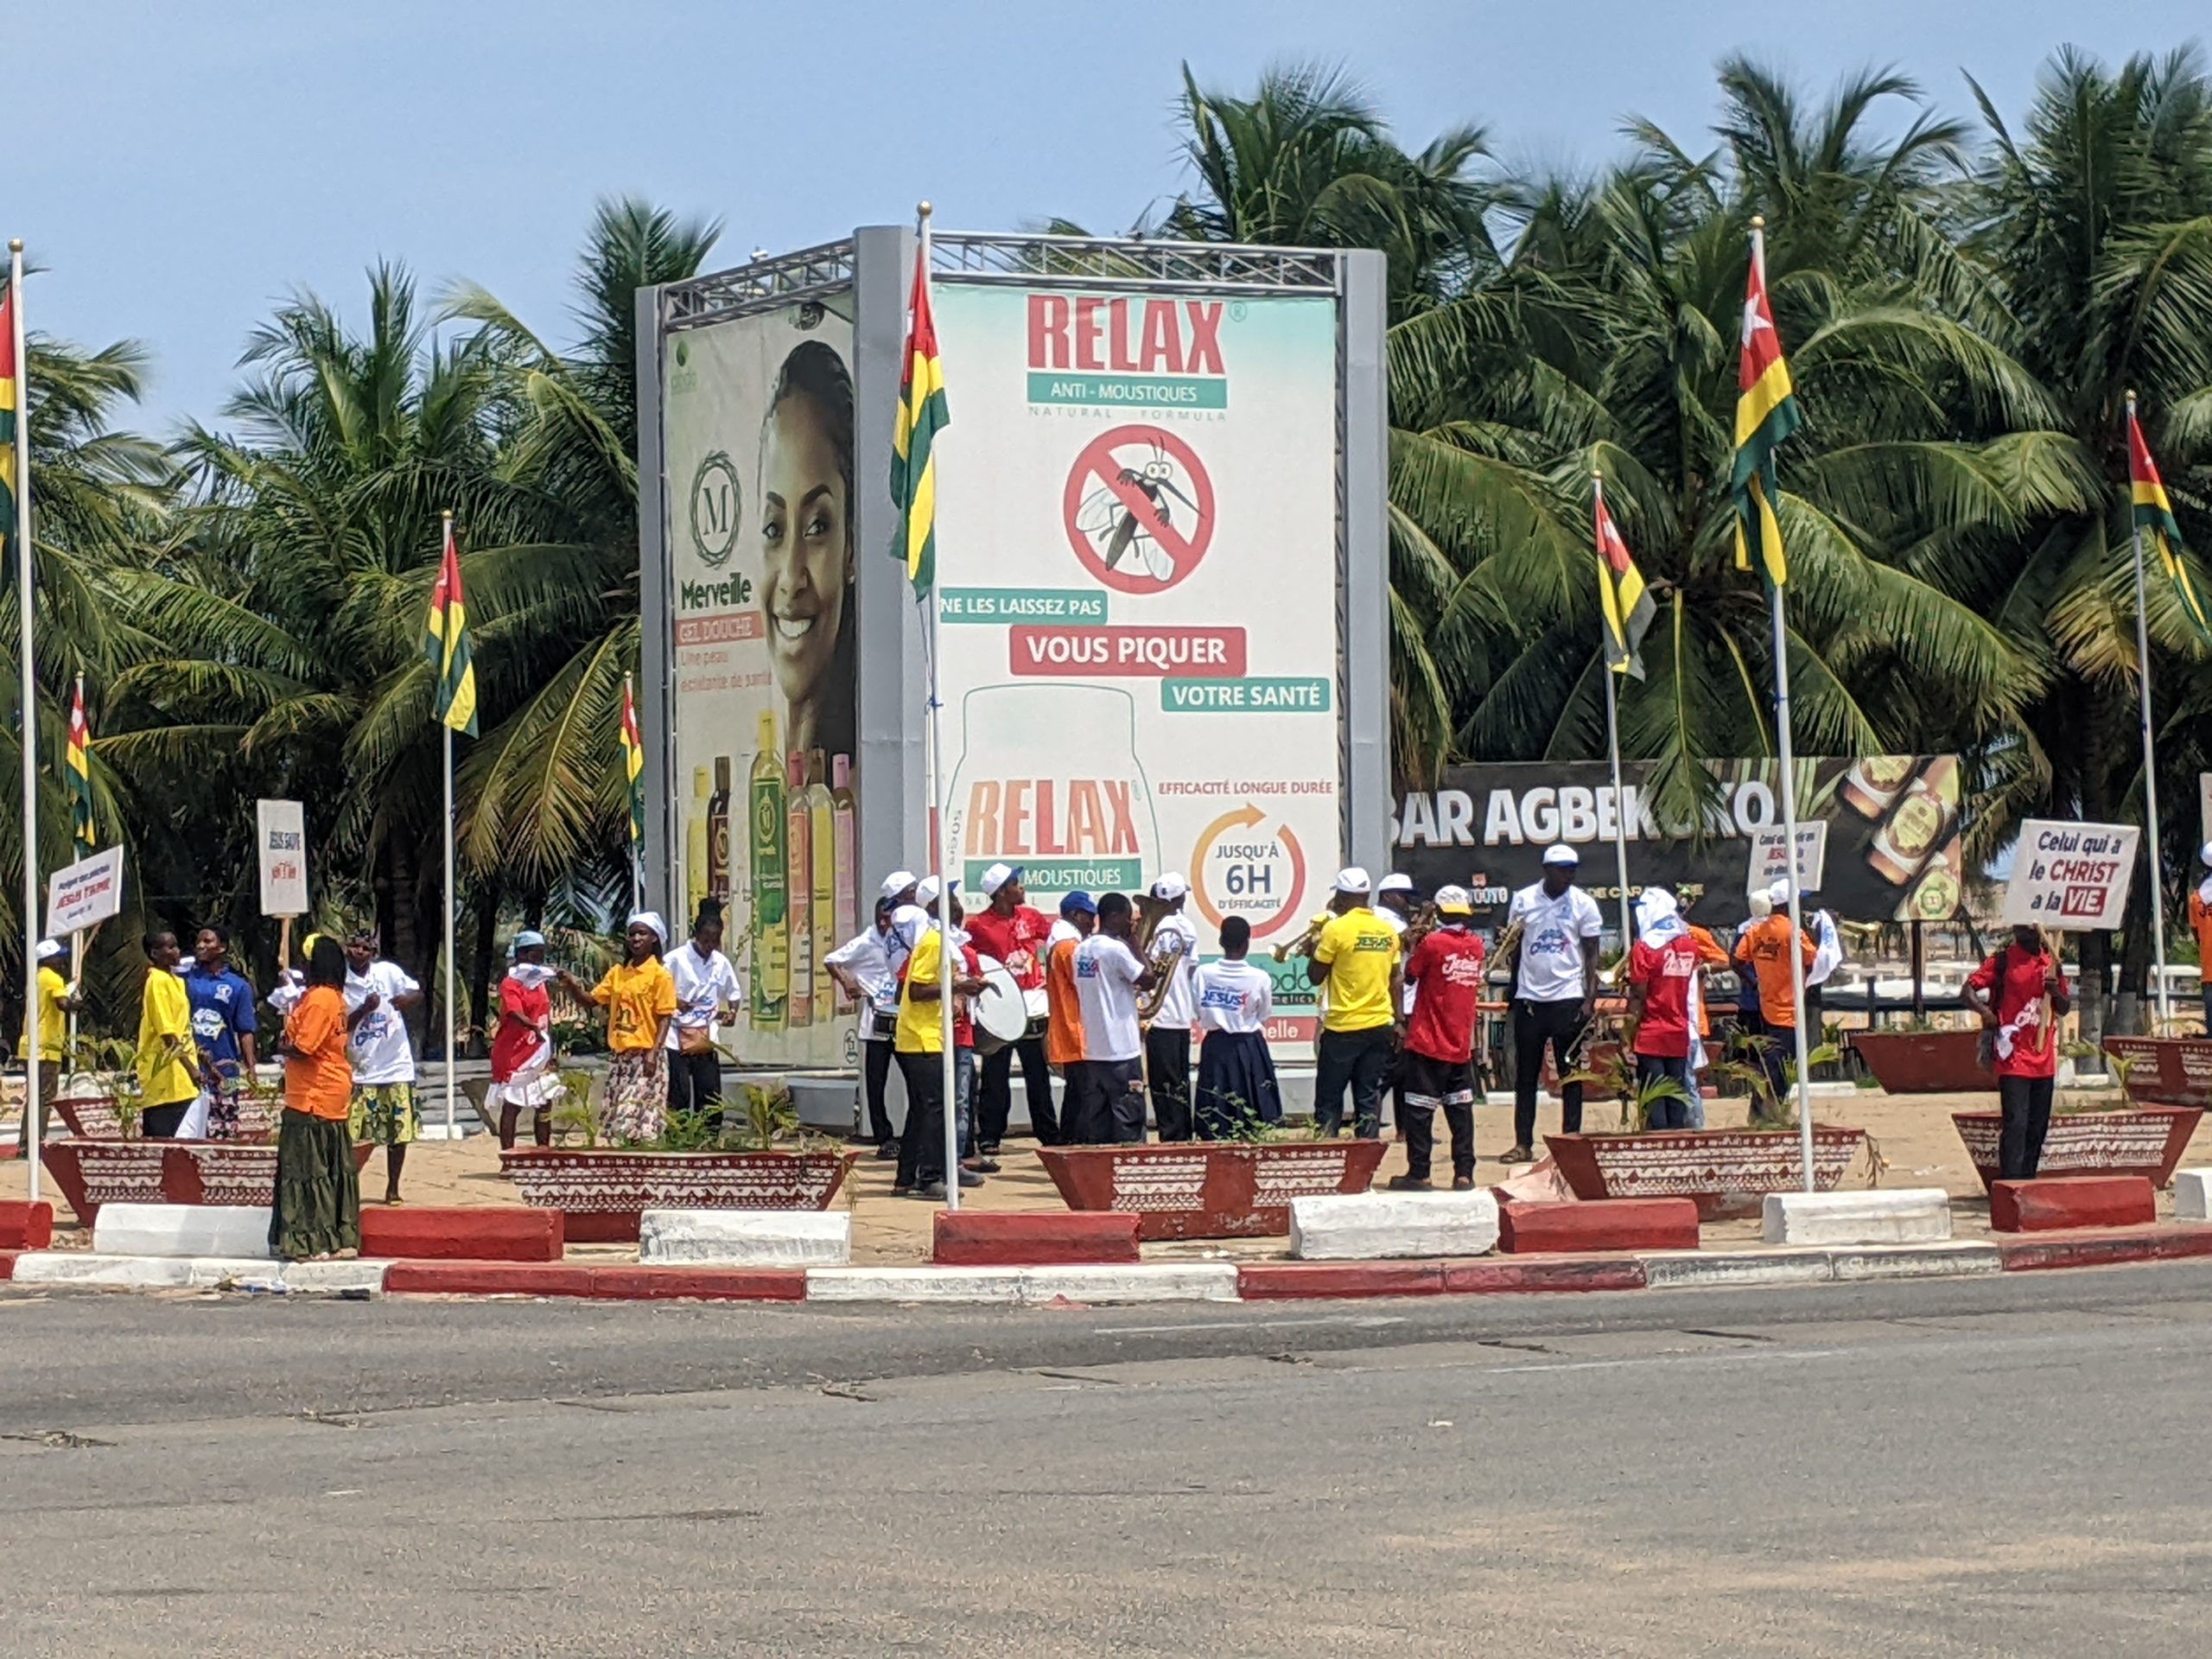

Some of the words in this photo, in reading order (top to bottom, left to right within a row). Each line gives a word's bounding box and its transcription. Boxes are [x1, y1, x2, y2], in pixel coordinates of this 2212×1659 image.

[1027, 294, 1225, 374] RELAX
[1051, 382, 1085, 398] ANTI
[1098, 383, 1198, 403] MOUSTIQUES
[1028, 407, 1112, 419] NATURAL
[1141, 410, 1227, 422] FORMULA
[681, 572, 753, 610] Merveille
[940, 598, 963, 614] NE
[966, 598, 995, 614] LES
[1000, 599, 1065, 615] LAISSEZ
[1069, 600, 1102, 615] PAS
[702, 616, 753, 640] DOUCHE
[1026, 635, 1109, 664] VOUS
[1118, 637, 1228, 671] PIQUER
[1172, 685, 1245, 706] VOTRE
[1249, 683, 1321, 706] SANTÉ
[1159, 779, 1230, 795] EFFICACITÉ
[1234, 782, 1287, 794] LONGUE
[1291, 779, 1332, 794] DURÉE
[965, 779, 1140, 855] RELAX
[1392, 790, 1475, 848] AR
[1216, 841, 1280, 861] JUSQU'À
[2037, 831, 2081, 853] Celui
[2082, 835, 2111, 856] qui
[2111, 837, 2122, 855] a
[1023, 868, 1122, 887] MOUSTIQUES
[1225, 864, 1271, 894] 6H
[2029, 859, 2045, 880] le
[2031, 893, 2043, 910] a
[2045, 890, 2062, 910] la
[2067, 888, 2102, 912] VIE
[1201, 990, 1243, 1006] JESUS
[1272, 994, 1313, 1002] metics
